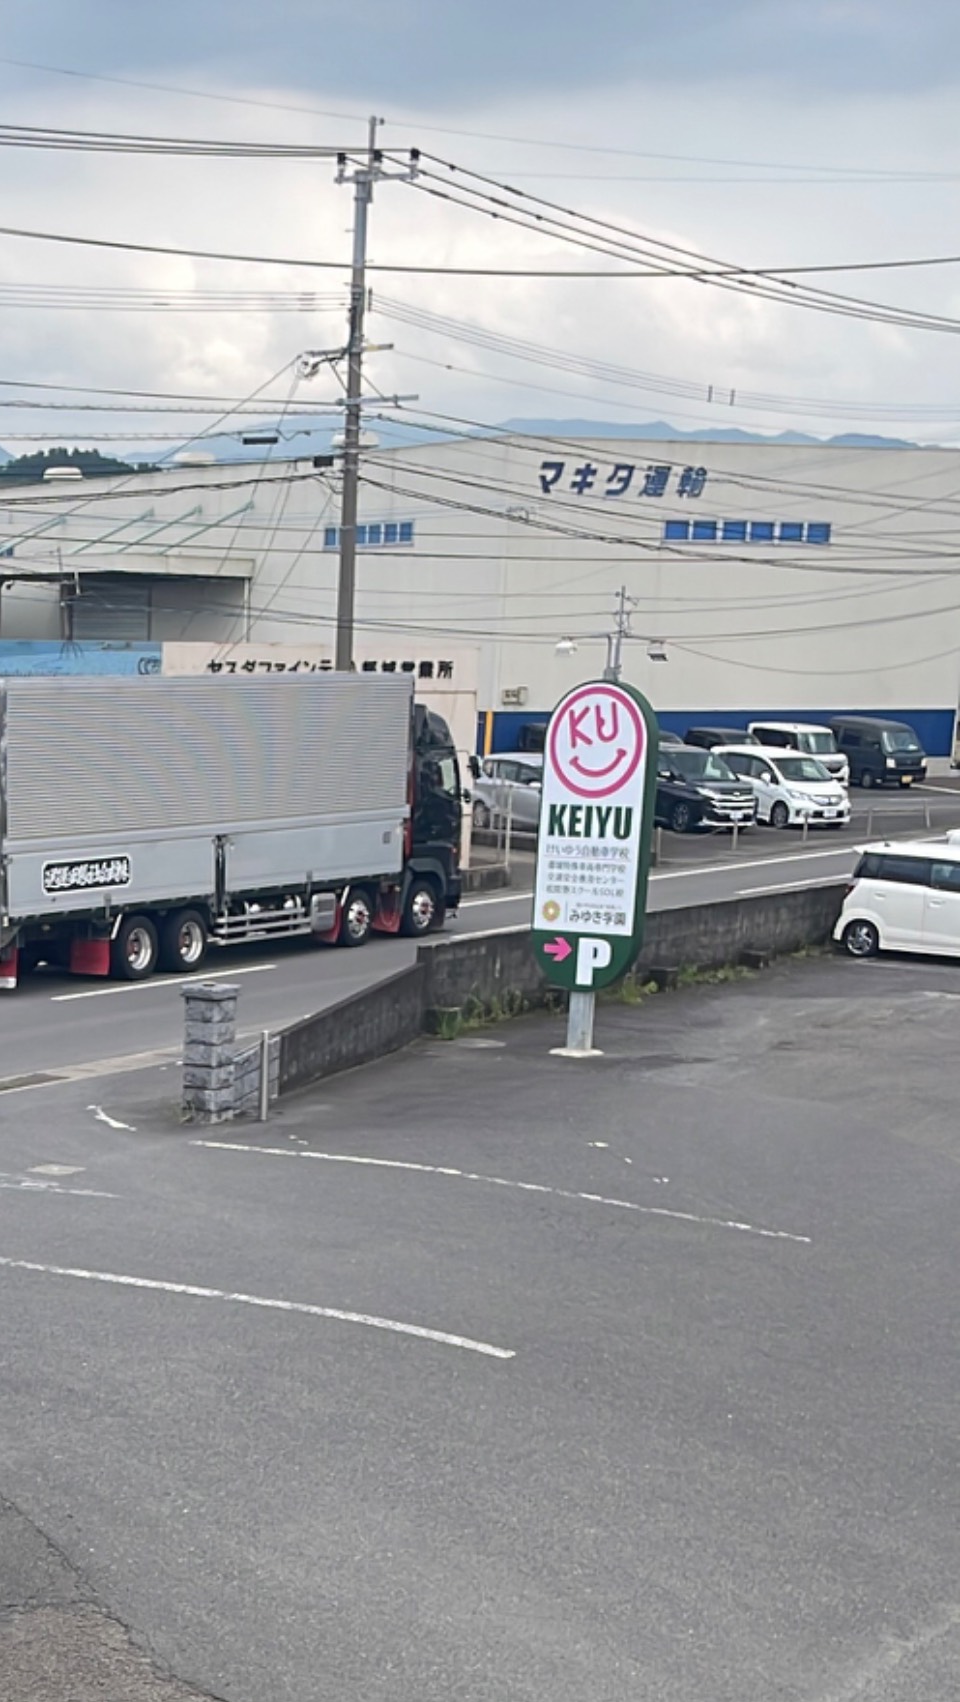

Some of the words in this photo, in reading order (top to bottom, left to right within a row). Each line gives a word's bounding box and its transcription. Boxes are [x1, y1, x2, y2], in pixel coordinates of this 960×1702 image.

[538, 461, 708, 499] マキタ運輸
[548, 803, 633, 840] KEIYU
[545, 844, 630, 859] けいゆう自動車学校
[569, 909, 626, 926] みゆき学園
[575, 937, 612, 986] P
